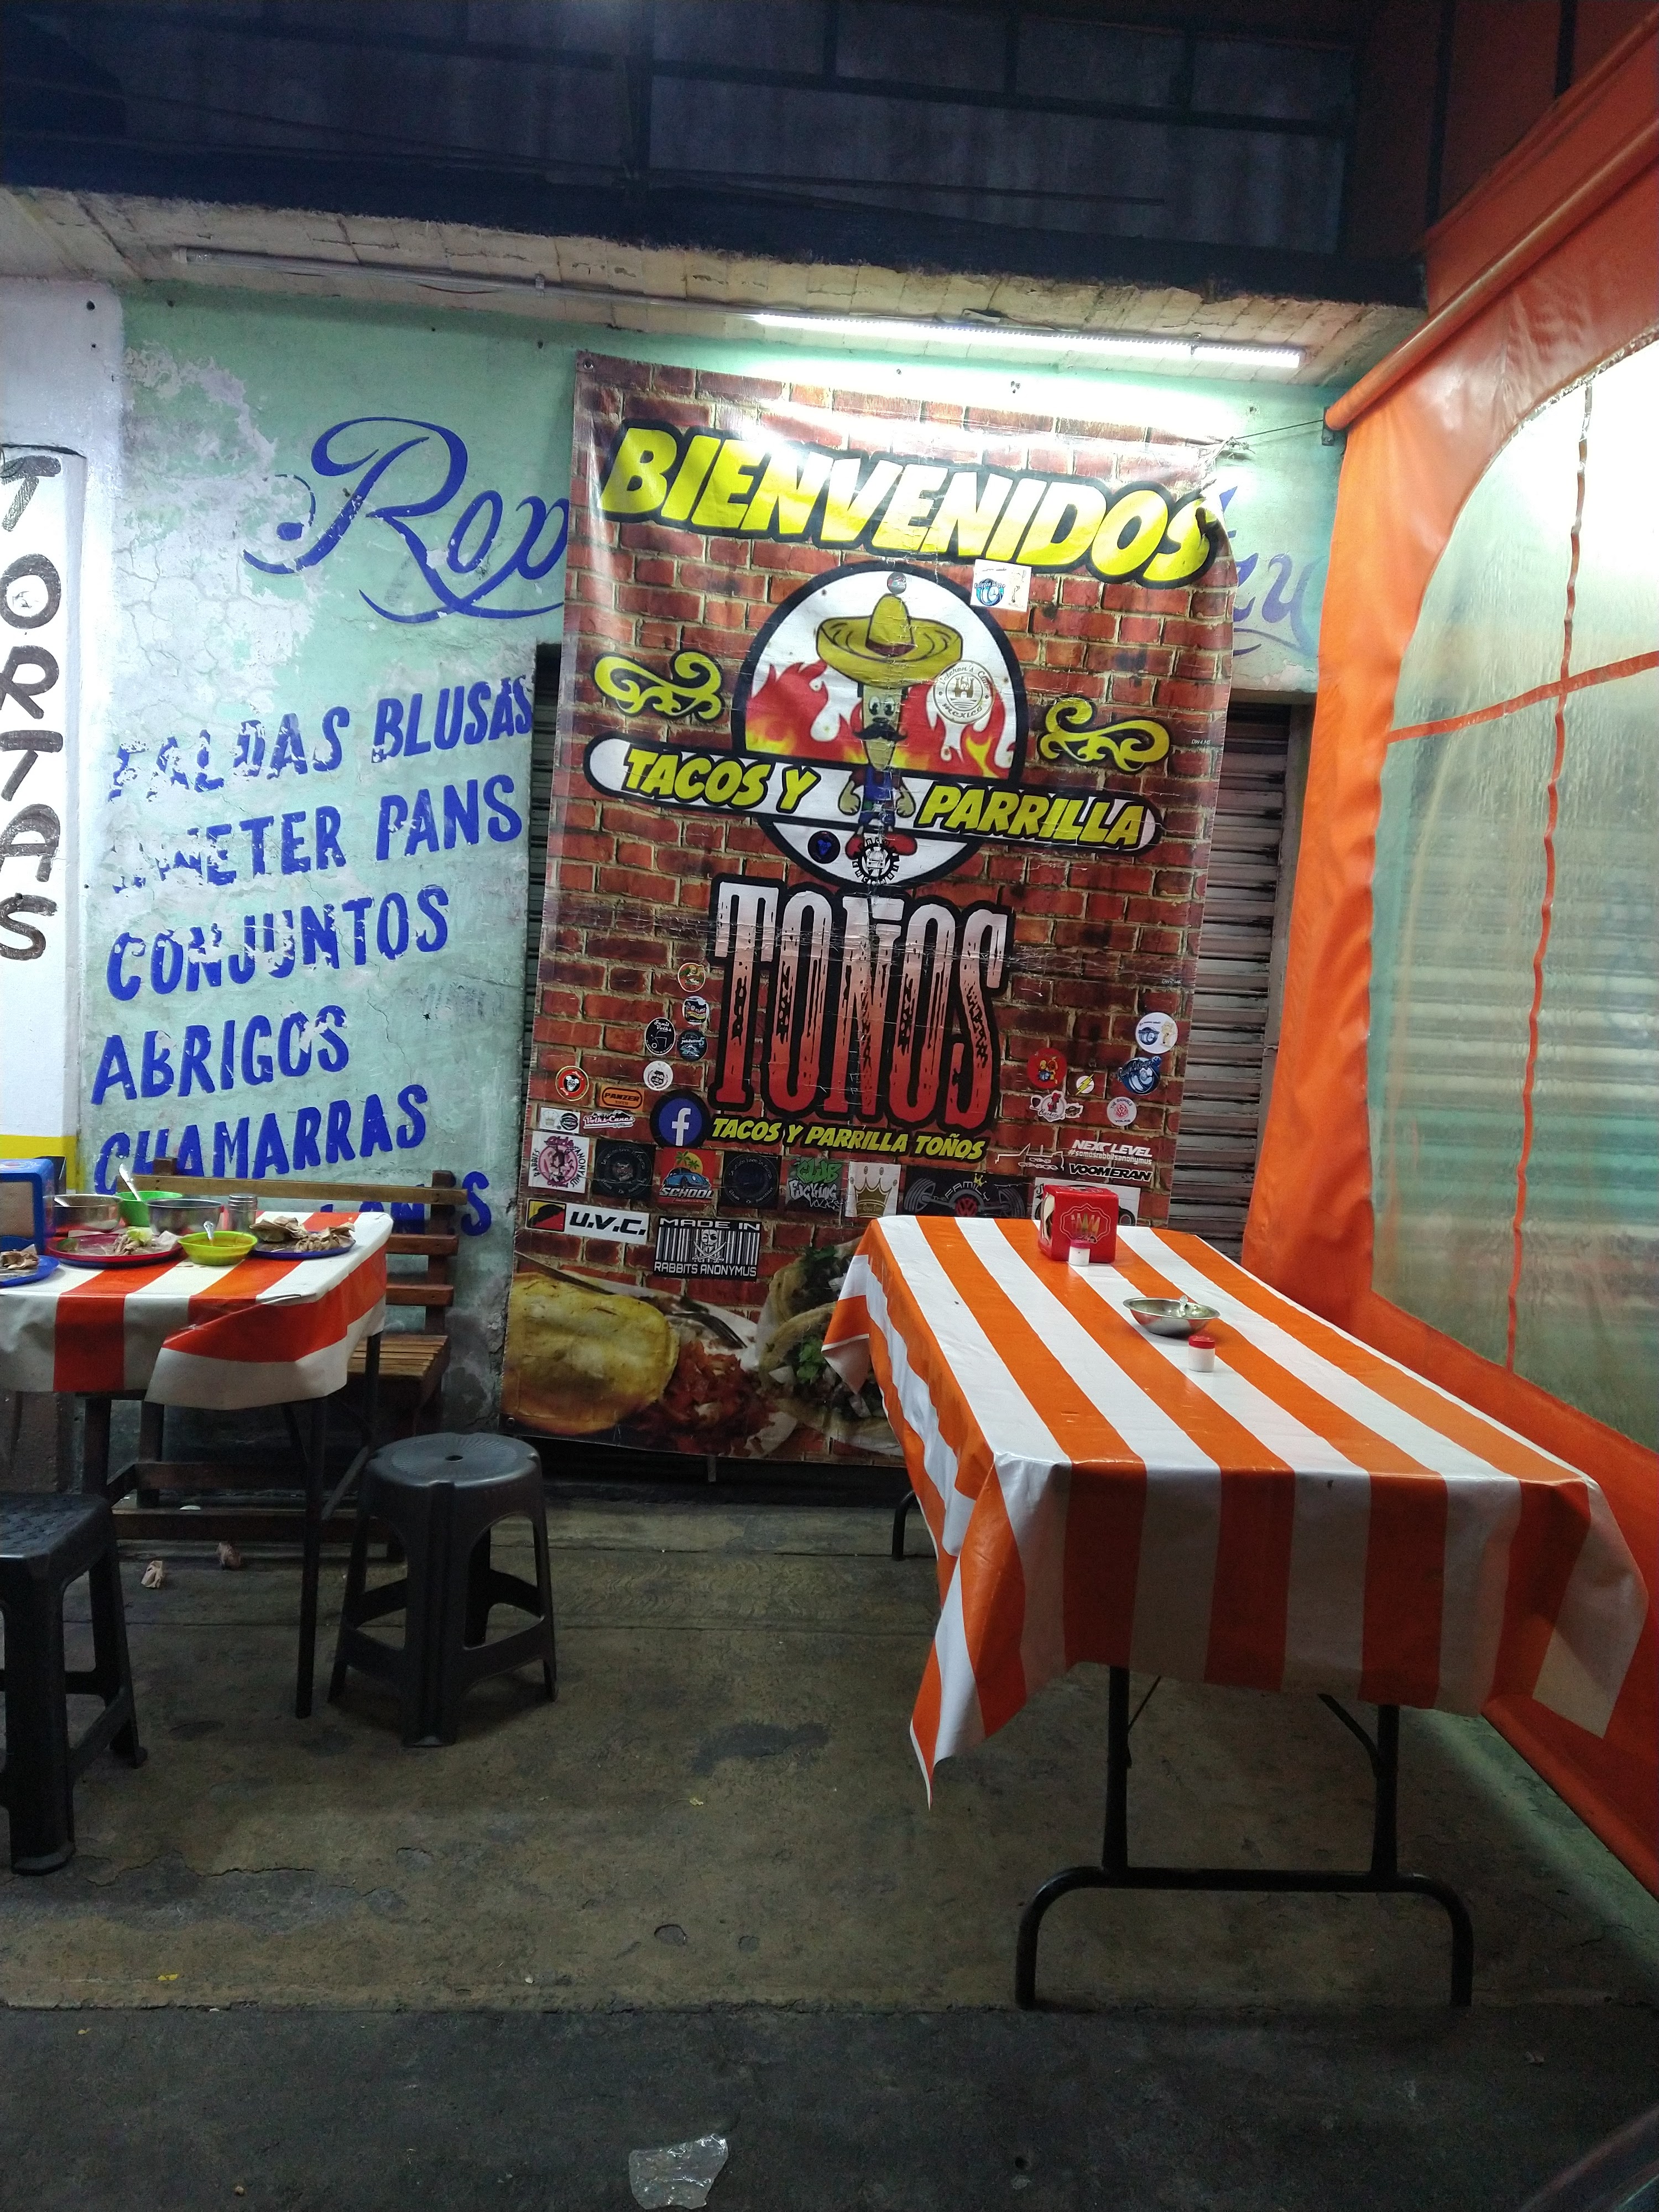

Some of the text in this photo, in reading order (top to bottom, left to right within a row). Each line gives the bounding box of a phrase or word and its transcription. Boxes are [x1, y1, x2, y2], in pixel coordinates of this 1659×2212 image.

[599, 423, 1221, 584] BIENVENIDOS
[372, 674, 533, 763] BLUSAS
[625, 748, 1145, 847] TACOS Y PARRILLA
[374, 775, 522, 861] PANS
[106, 885, 449, 1000] CONJUNTOS
[91, 1005, 349, 1105] ABRIGOS
[604, 1092, 640, 1102] PANZER
[94, 1083, 429, 1194] CHAMARRAS
[712, 1118, 986, 1160] TACOS Y PARRILLA TOÑOS
[1109, 1143, 1153, 1157] LEVEL
[1069, 1163, 1153, 1182] VOOMERAN
[659, 1187, 713, 1199] SCHOOL
[945, 1181, 990, 1201] FAMILY
[570, 1211, 646, 1236] U.V.C.
[660, 1218, 760, 1231] MADE IN
[654, 1261, 757, 1277] RABBITS ANONYMUS
